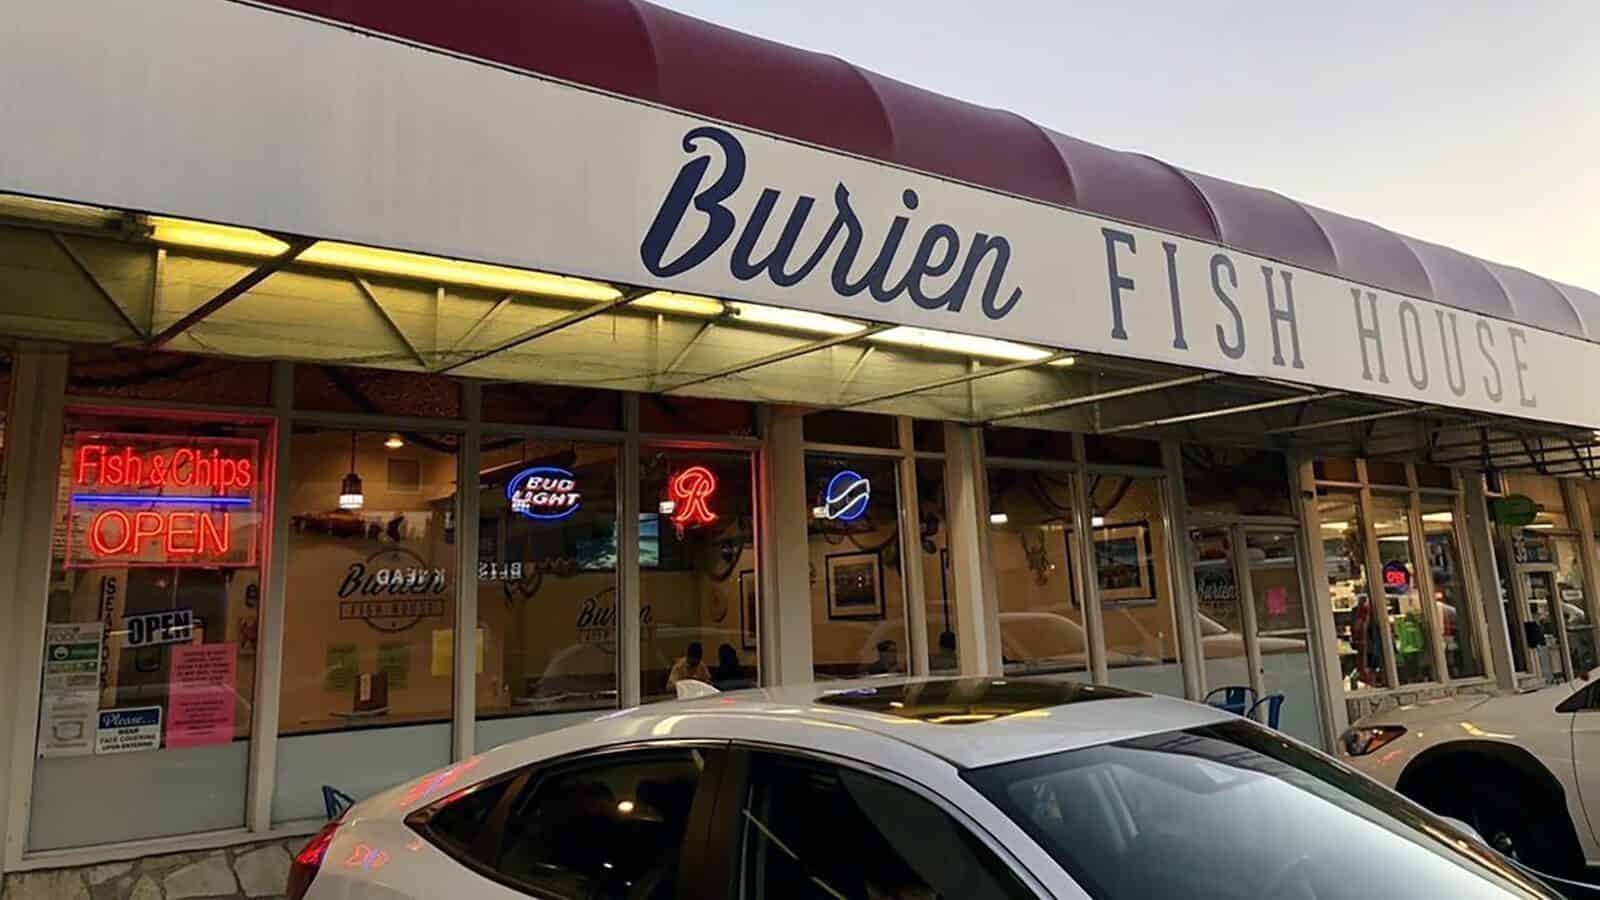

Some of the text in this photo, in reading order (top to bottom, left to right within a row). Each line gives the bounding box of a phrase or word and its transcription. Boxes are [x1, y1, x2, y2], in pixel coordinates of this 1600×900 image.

[640, 127, 1537, 409] Burien FISH HOUSE
[77, 444, 251, 496] Fish & Chips
[526, 476, 576, 492] BUD
[511, 489, 581, 507] LIGHT
[93, 509, 230, 554] OPEN
[128, 612, 190, 644] OPEN
[576, 599, 652, 627] Burn
